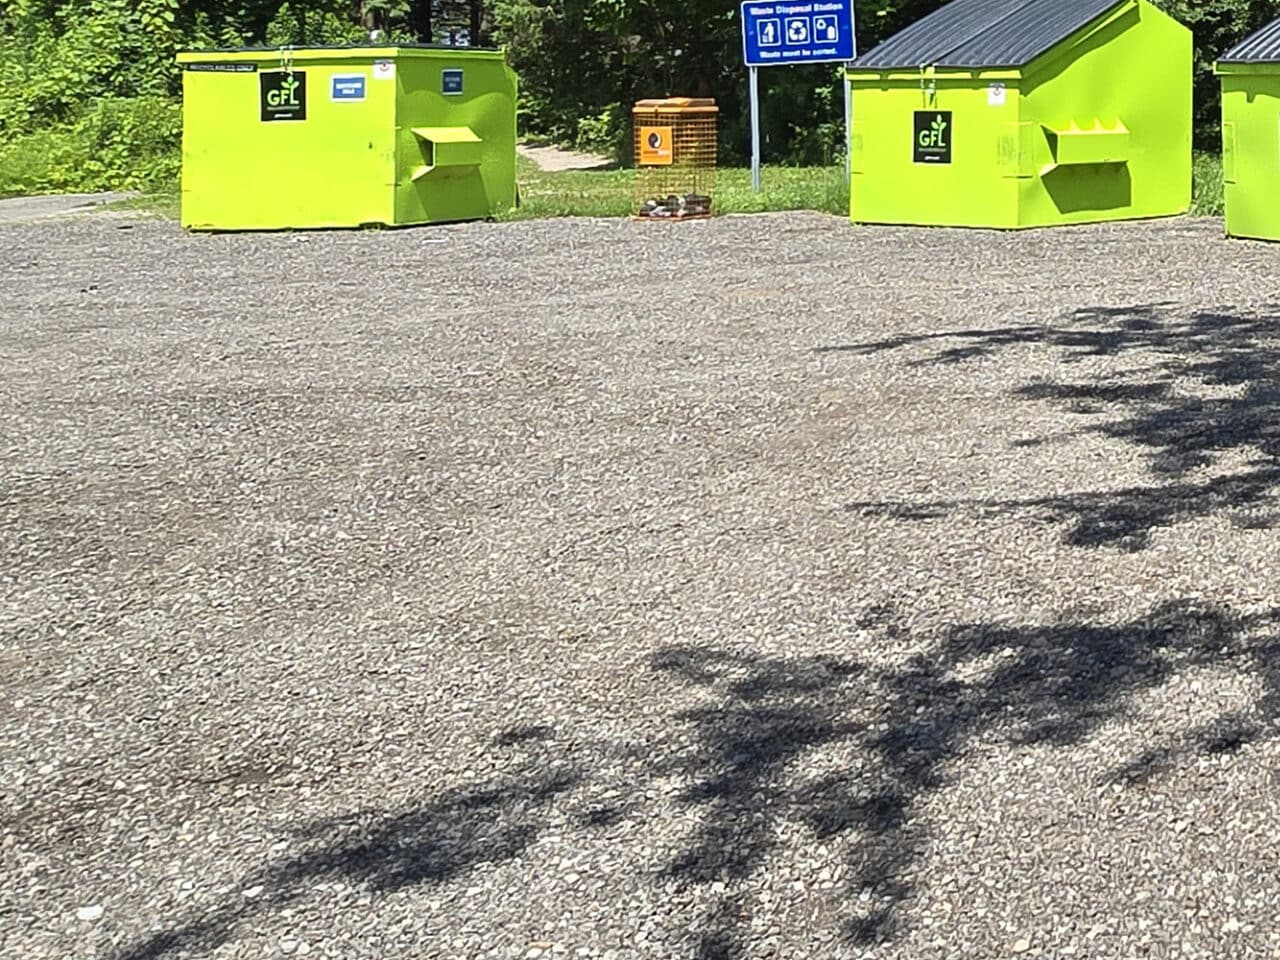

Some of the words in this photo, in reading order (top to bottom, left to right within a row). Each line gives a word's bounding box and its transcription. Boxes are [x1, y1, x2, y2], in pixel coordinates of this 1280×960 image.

[750, 7, 774, 15] Waste
[776, 4, 812, 14] Disposal
[814, 3, 843, 12] Station
[267, 84, 300, 106] GFL
[919, 124, 946, 147] GFL
